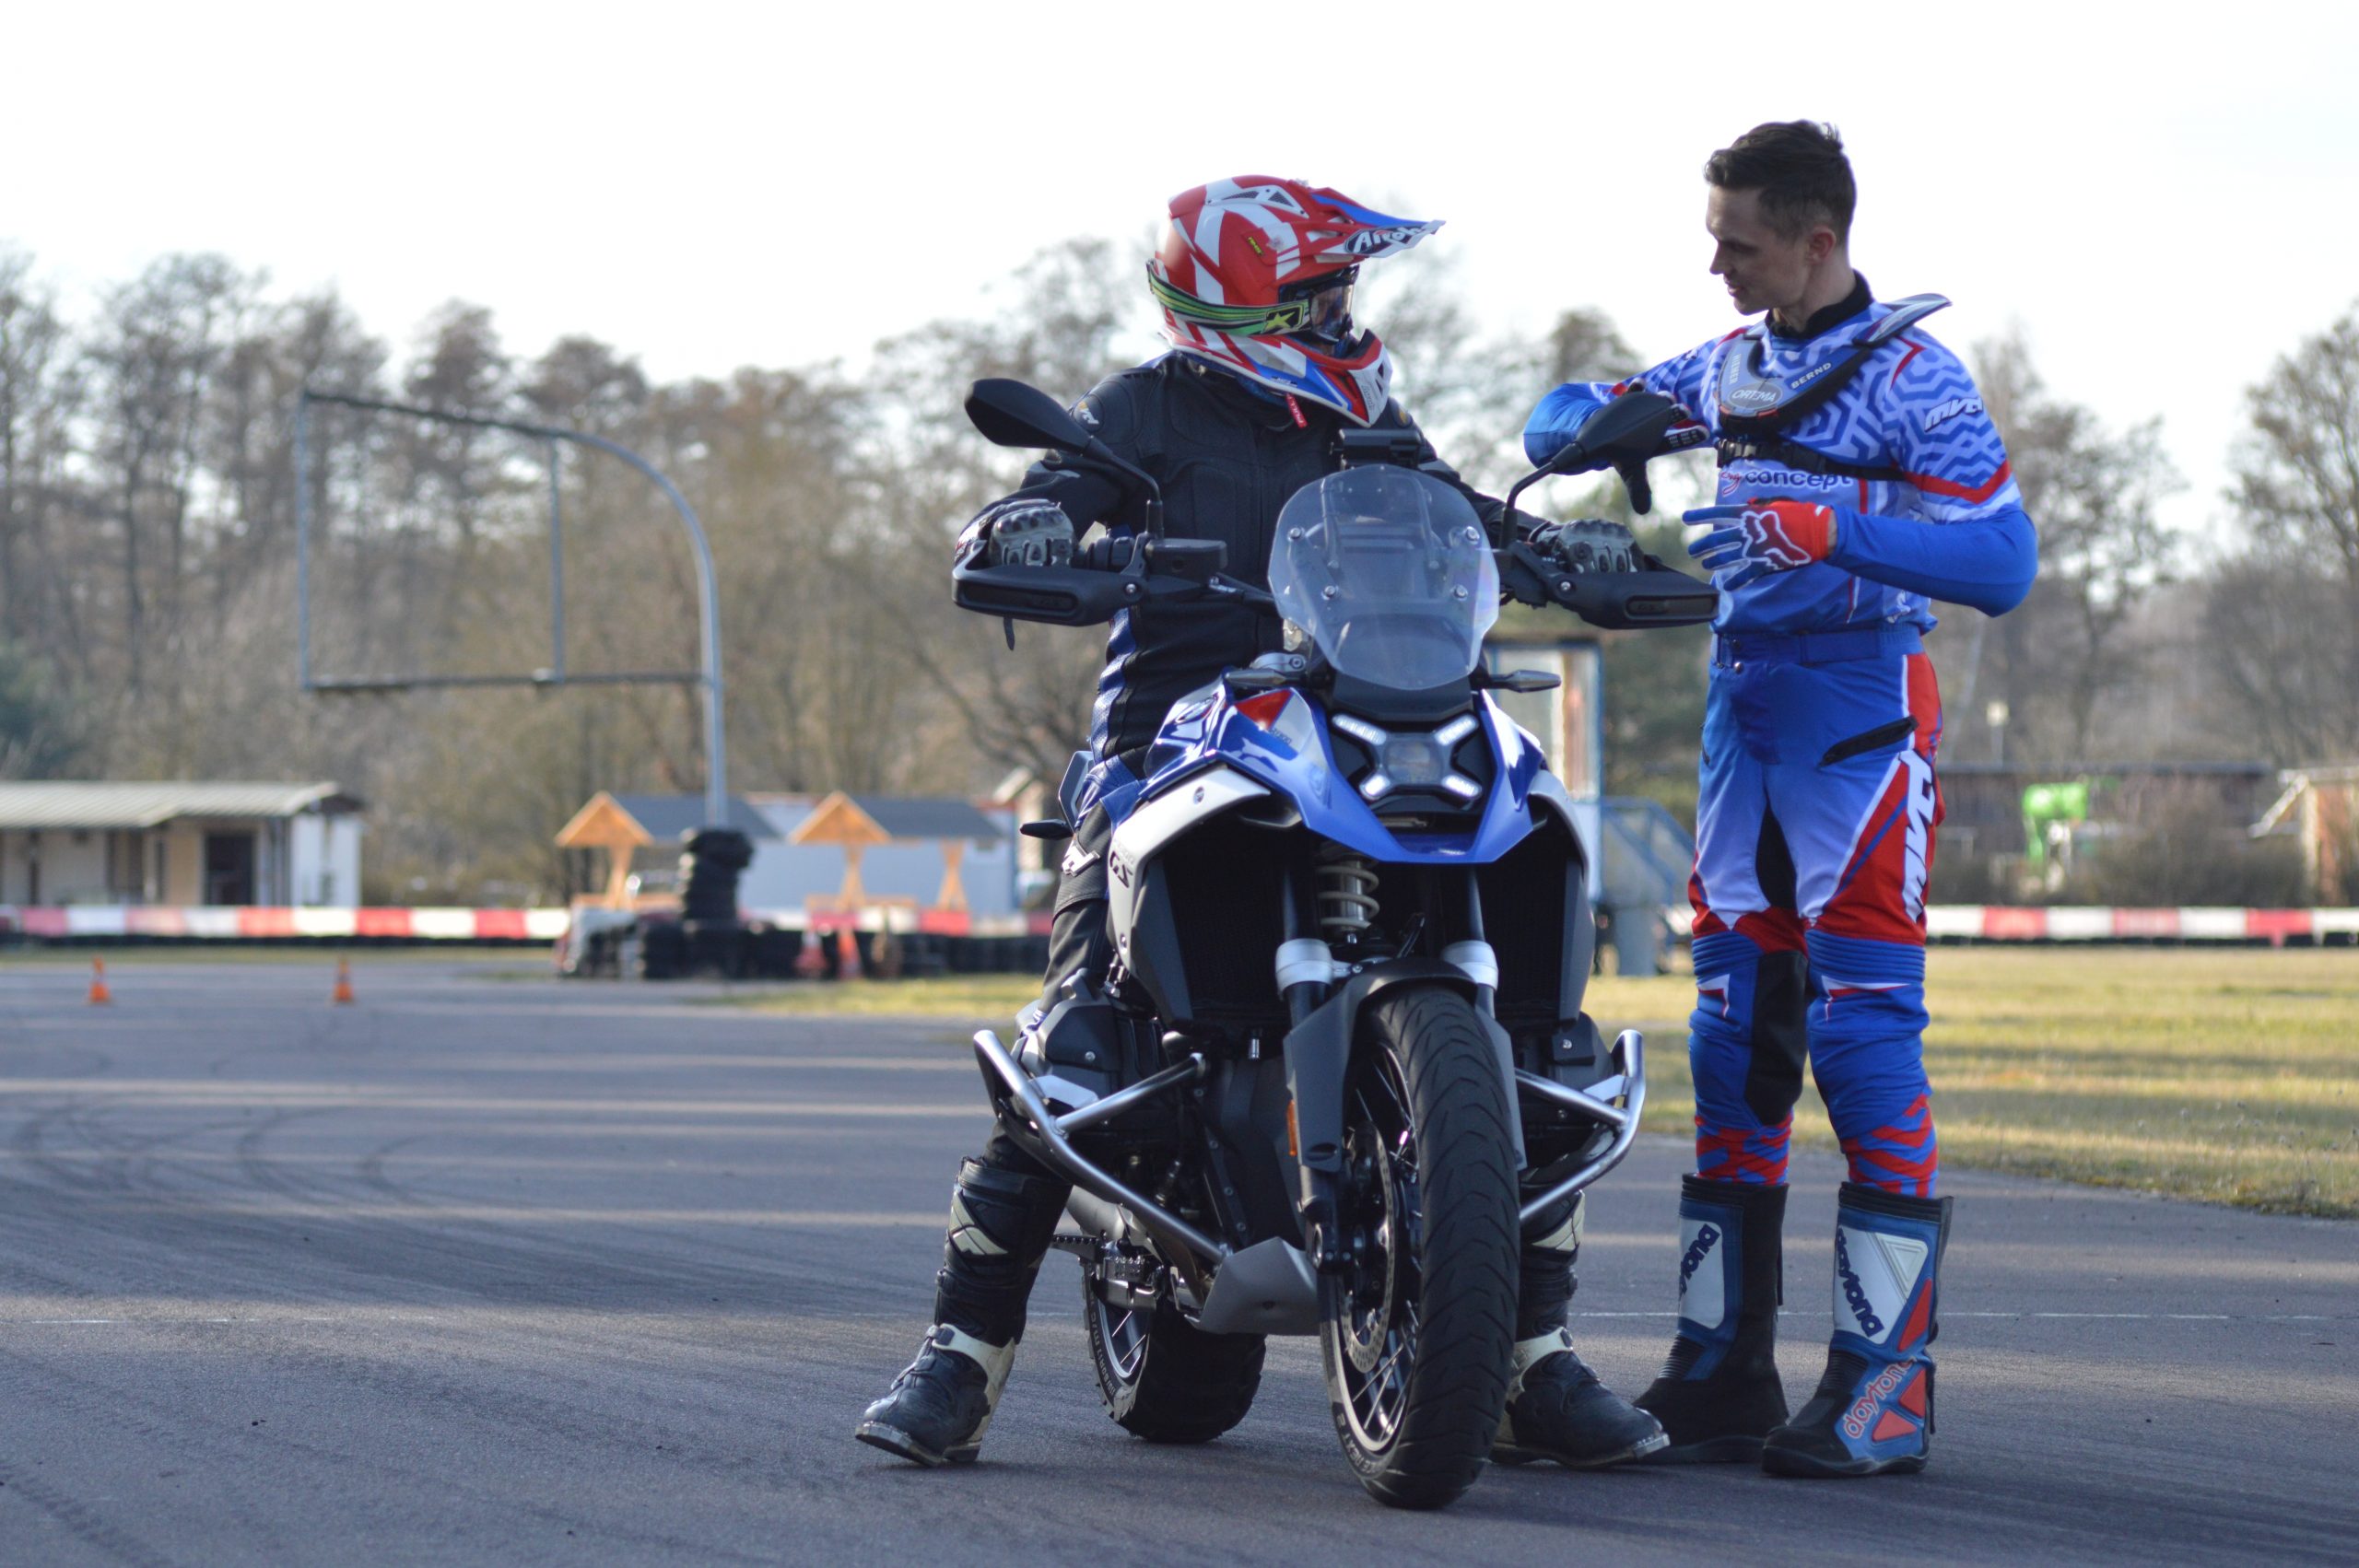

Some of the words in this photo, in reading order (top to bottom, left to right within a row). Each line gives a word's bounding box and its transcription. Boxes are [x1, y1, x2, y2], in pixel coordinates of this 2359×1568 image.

[1790, 362, 1832, 389] BERND
[1731, 389, 1778, 403] ORTEMA
[1744, 470, 1853, 492] concept
